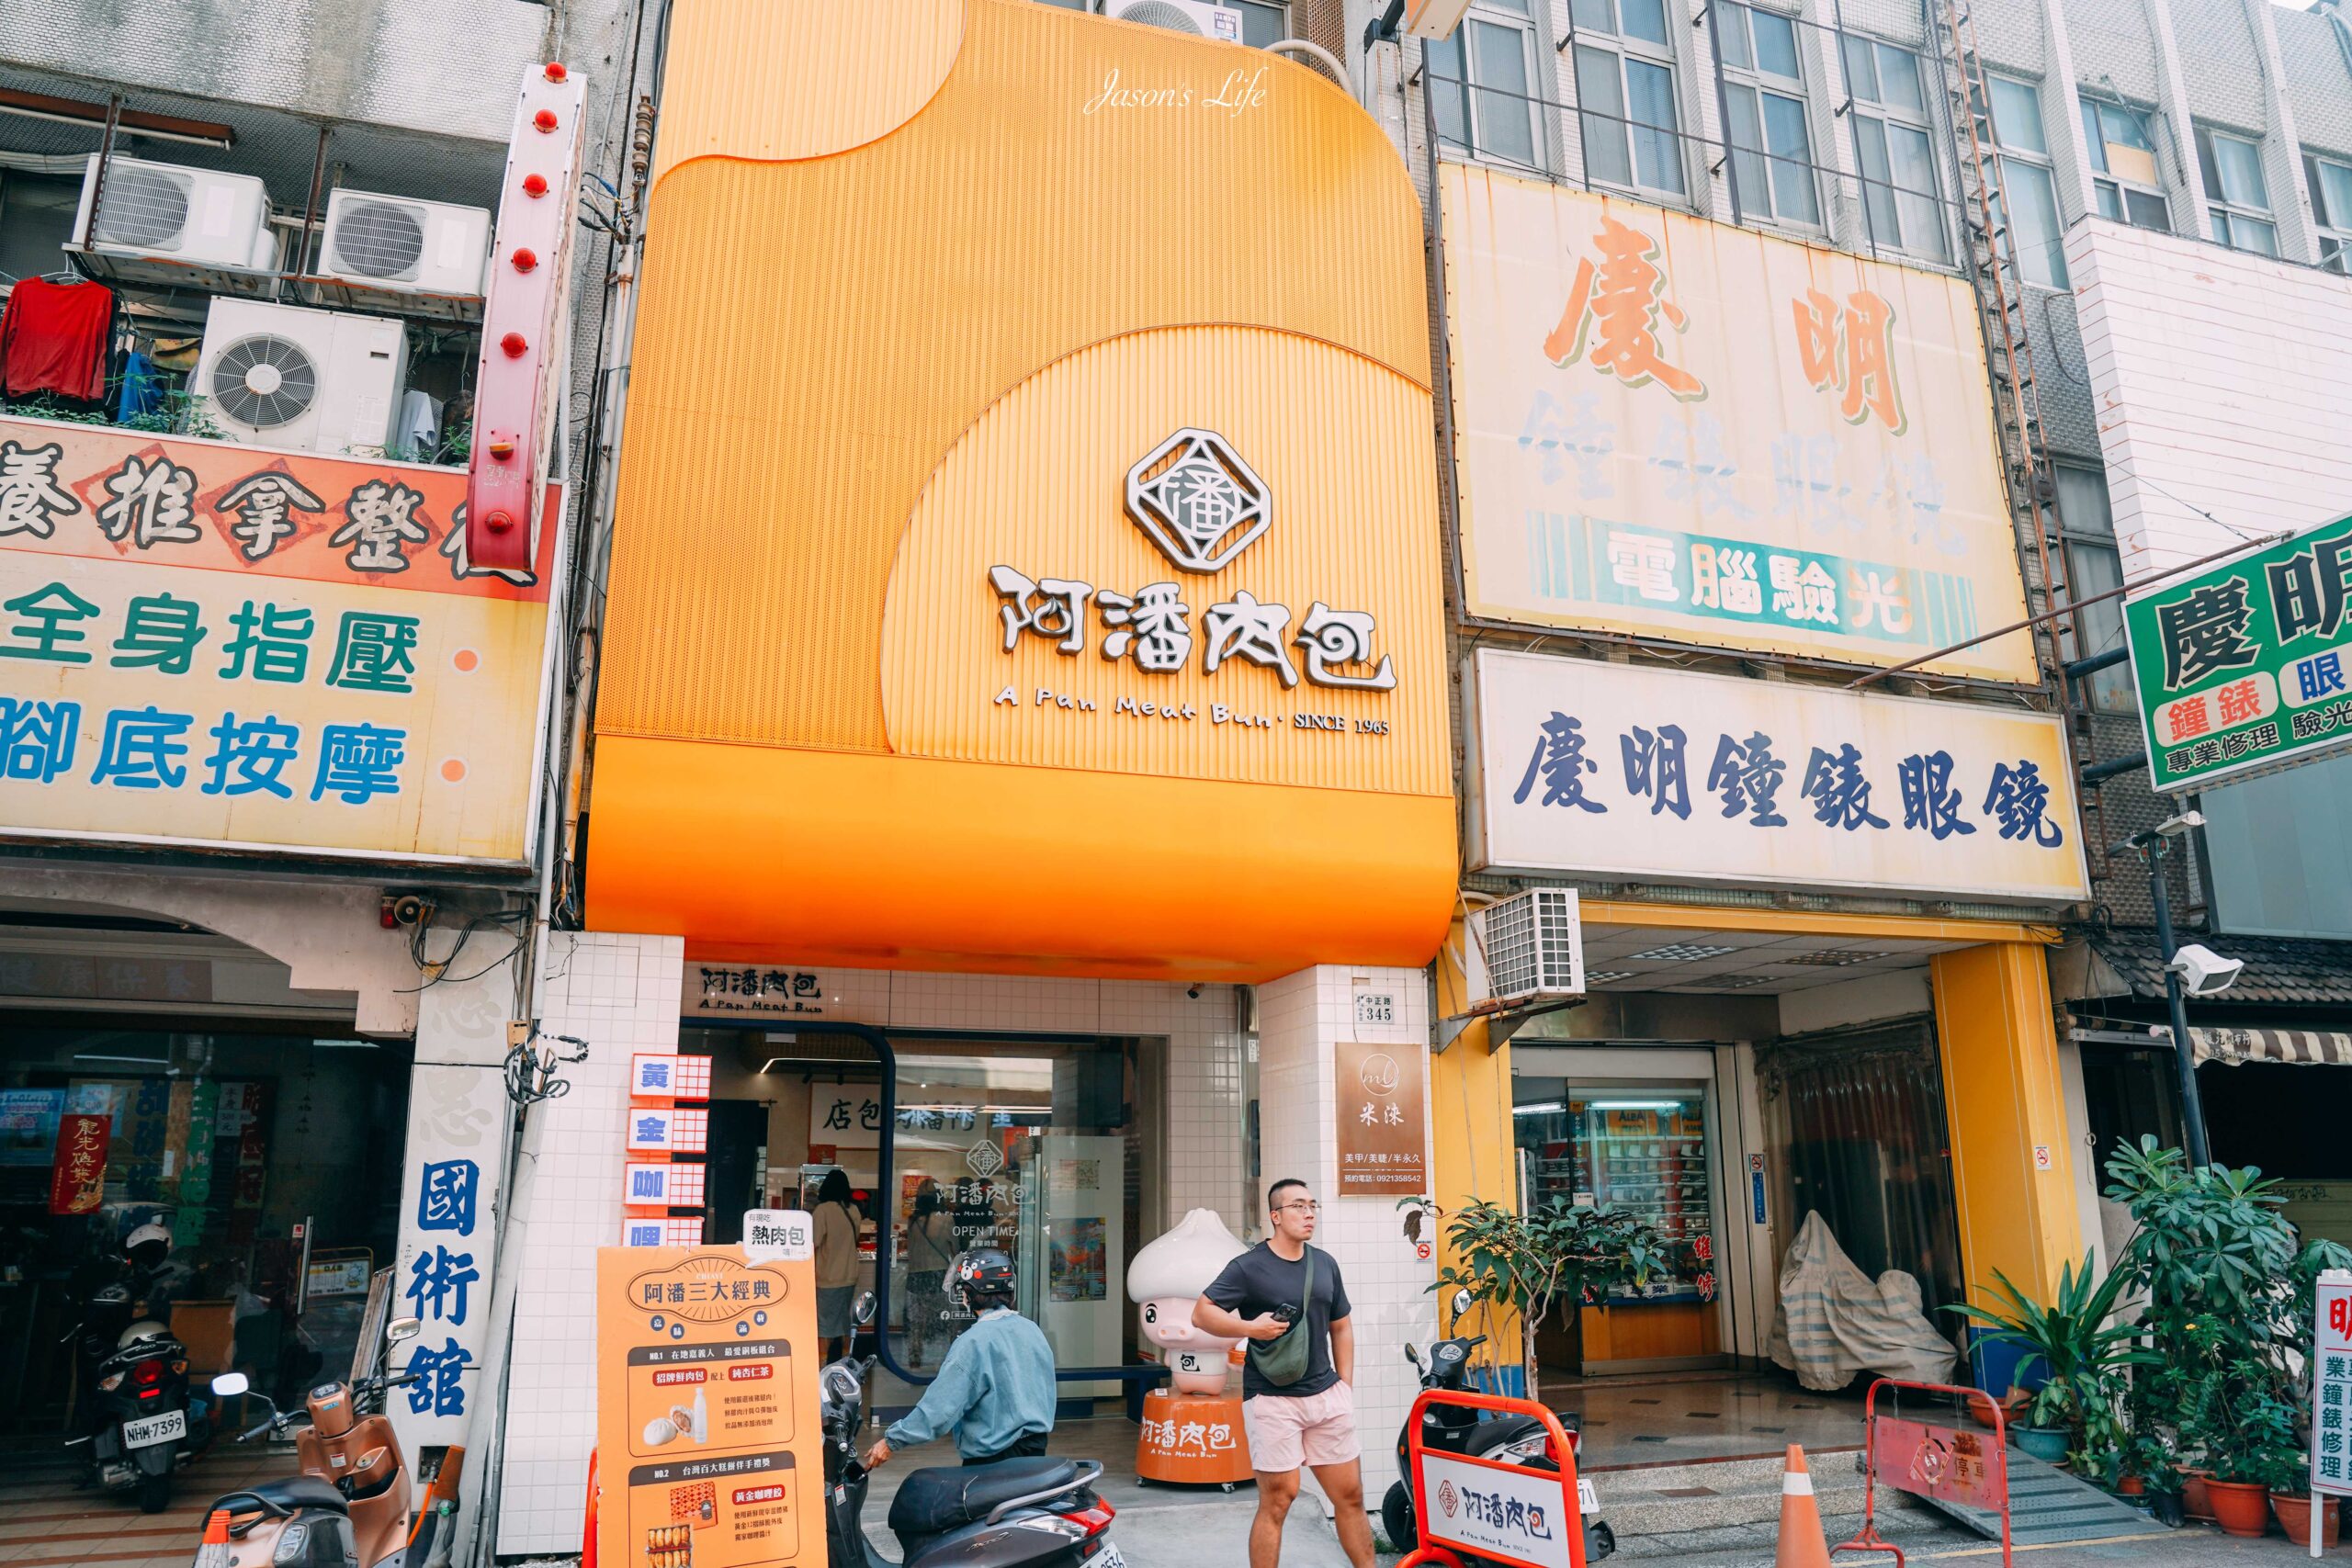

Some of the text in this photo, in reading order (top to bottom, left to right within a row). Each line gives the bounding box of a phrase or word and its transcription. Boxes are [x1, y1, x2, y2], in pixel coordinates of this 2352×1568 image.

[0, 441, 538, 586] 養推拿整
[1608, 530, 1914, 635] 電腦驗光
[0, 581, 420, 694] 全身指壓
[988, 565, 1398, 692] 阿潘肉包
[994, 686, 1019, 705] A
[1035, 688, 1097, 712] Pan
[1115, 696, 1196, 719] Meat
[1294, 714, 1345, 731] SINCE
[1354, 718, 1389, 736] 1965
[0, 696, 407, 805] 腳底按摩
[2167, 723, 2279, 773] 專業修理
[1514, 711, 2063, 848] 慶明鐘錶眼鏡
[700, 967, 821, 999] 阿潘肉包
[1366, 997, 1390, 1005] 中正路
[1367, 1008, 1391, 1021] 345
[933, 1182, 1035, 1206] 阿潘肉包
[752, 1225, 805, 1246] 熱肉包
[952, 1226, 1015, 1236] OPEN TIME
[644, 1280, 771, 1303] 阿潘三大經典
[1140, 1416, 1237, 1451] 阿潘肉包
[2320, 1383, 2343, 1479] 鐘錶修理
[1461, 1486, 1553, 1540] 阿潘肉包
